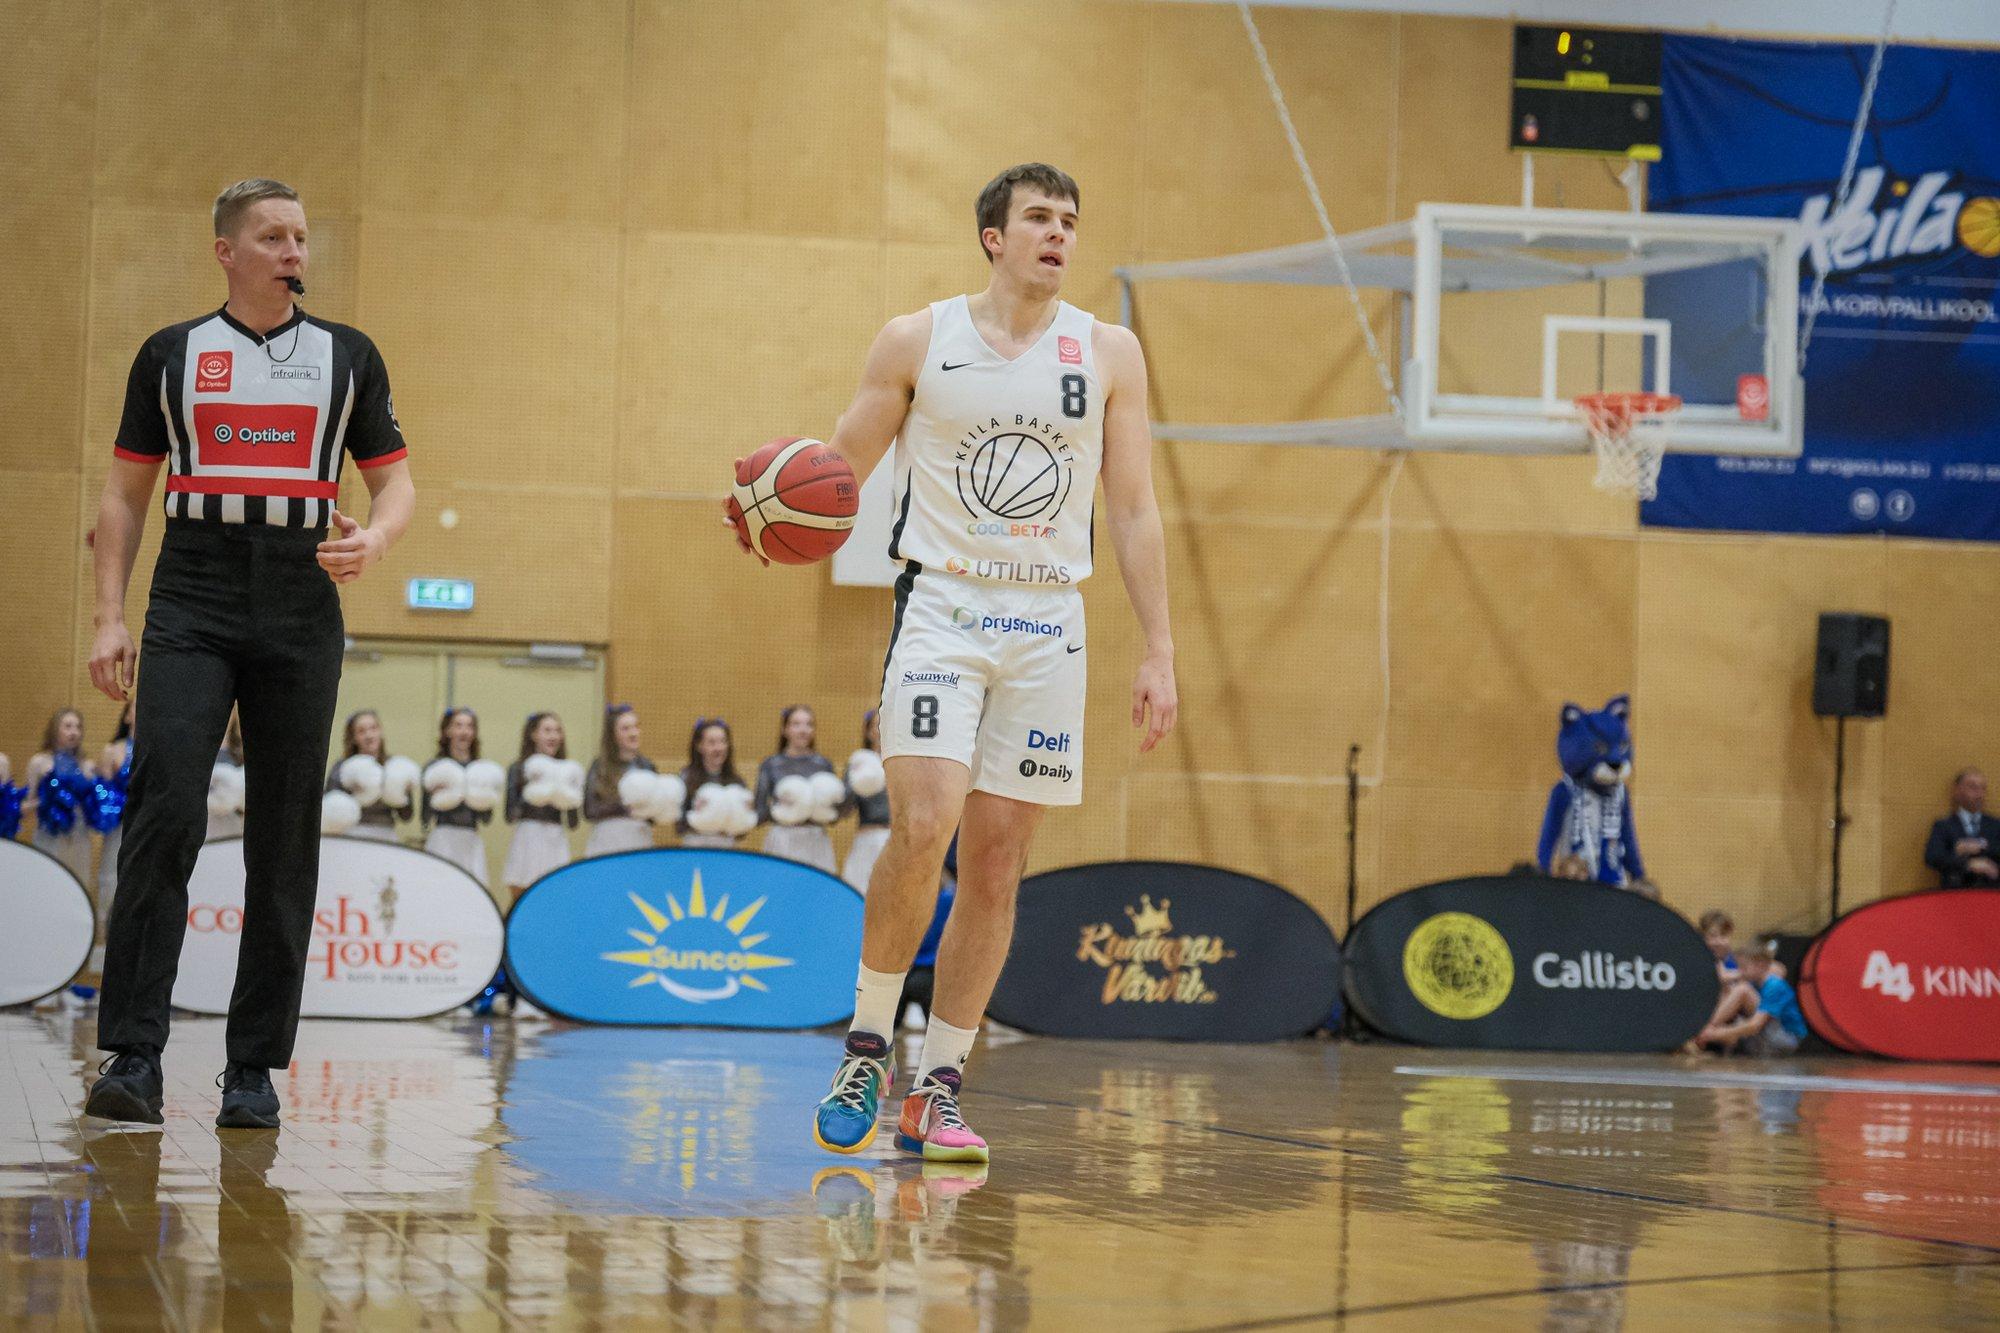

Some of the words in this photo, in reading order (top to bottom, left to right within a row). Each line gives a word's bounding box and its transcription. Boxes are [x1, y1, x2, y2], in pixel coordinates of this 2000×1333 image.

[1797, 165, 1964, 272] Keila
[1060, 373, 1087, 419] 8
[239, 427, 296, 445] Optibet
[955, 417, 1001, 461] KEILA
[1014, 414, 1074, 463] BASKET
[967, 523, 1041, 538] COOLBET
[976, 561, 1071, 584] UTILITAS
[982, 616, 1062, 637] prysmian
[902, 671, 960, 685] Scanweld
[911, 695, 939, 738] 8
[1038, 764, 1073, 782] Daily
[1533, 950, 1676, 991] Callisto
